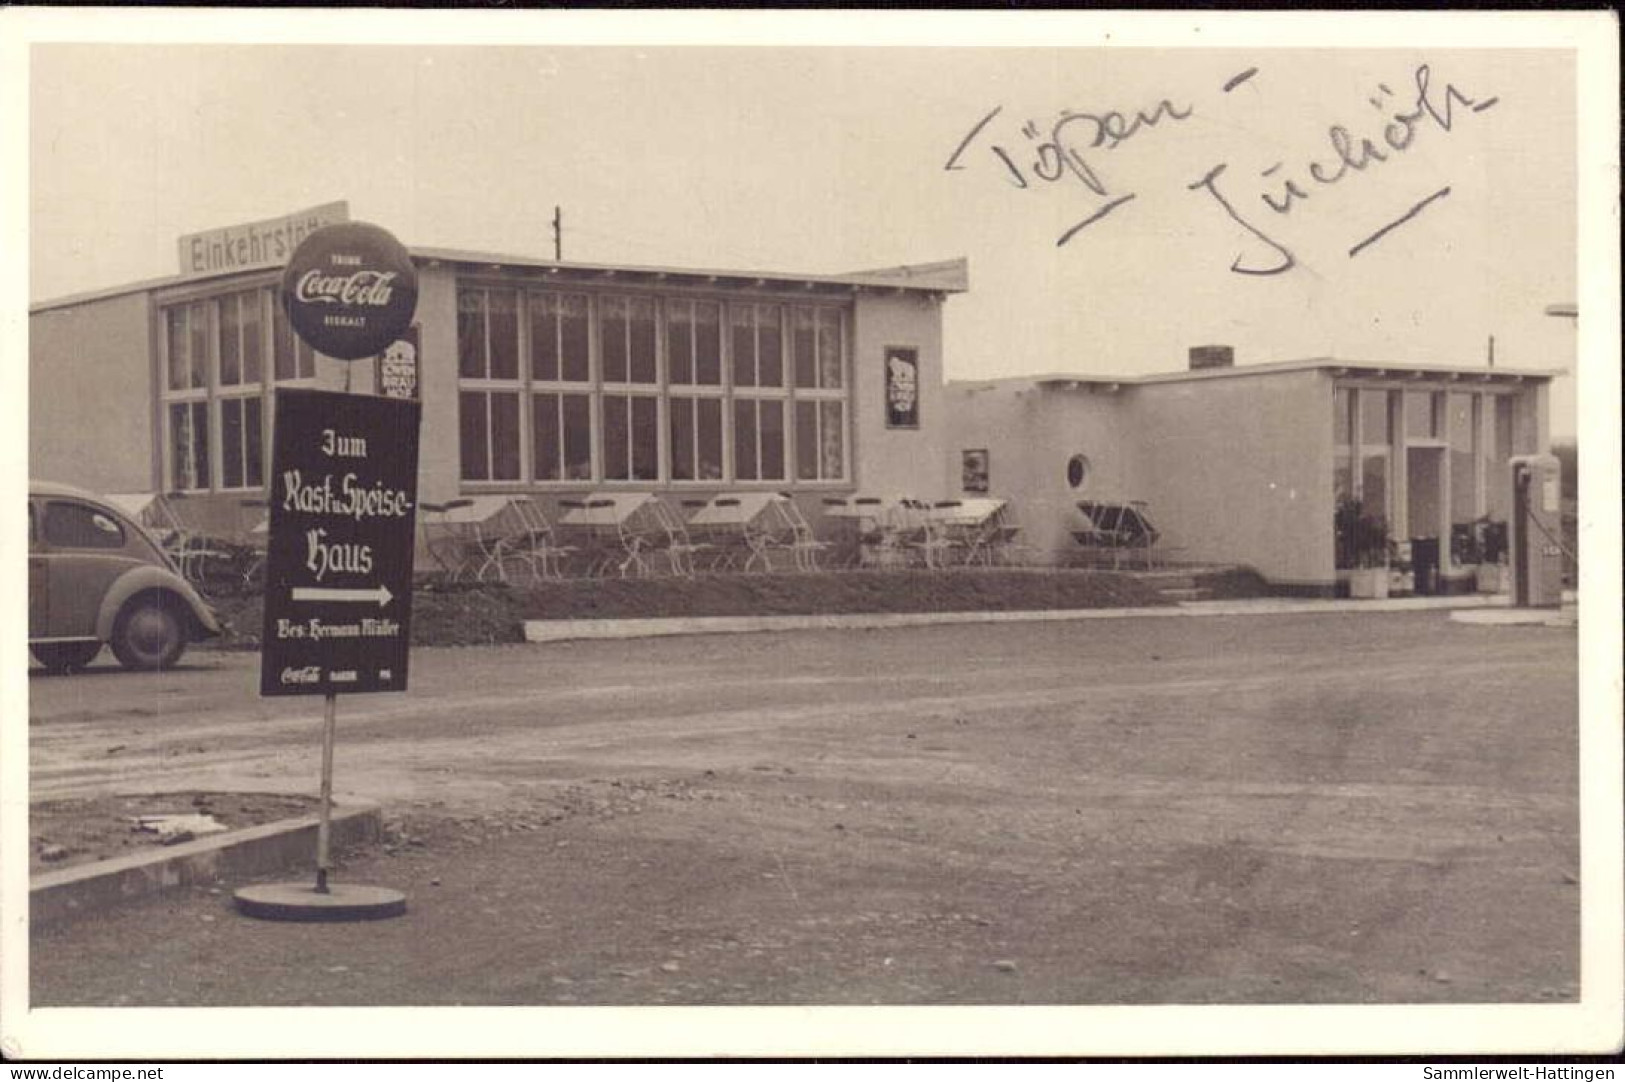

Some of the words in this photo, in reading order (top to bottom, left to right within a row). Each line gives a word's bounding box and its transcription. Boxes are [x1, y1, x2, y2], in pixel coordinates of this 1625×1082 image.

[296, 269, 397, 305] Coca-Cola
[324, 315, 366, 327] EISKALT
[305, 527, 373, 581] Haus
